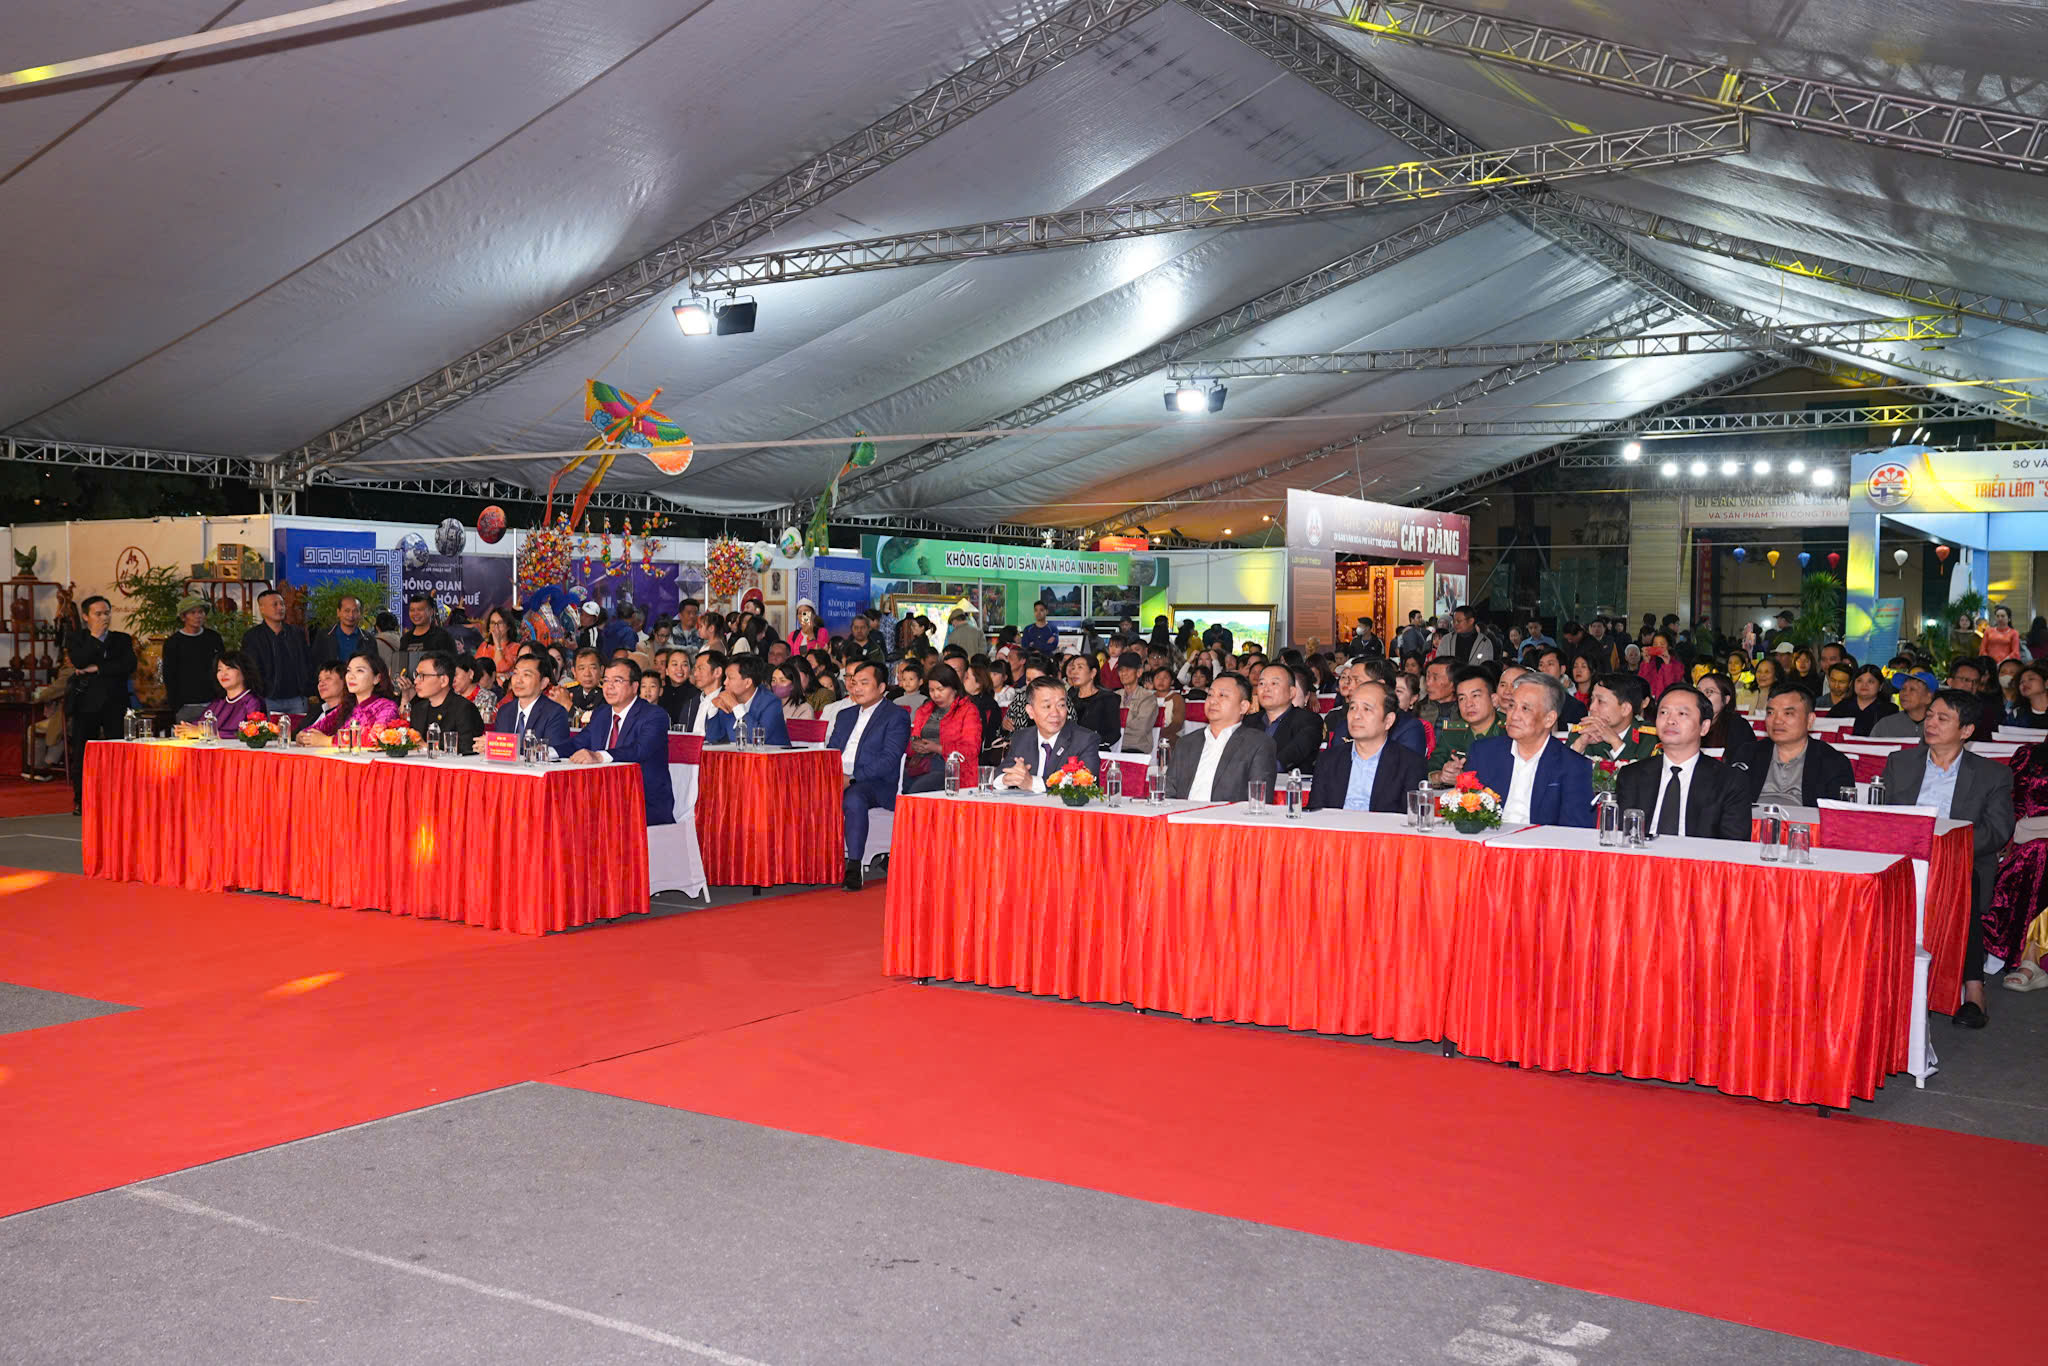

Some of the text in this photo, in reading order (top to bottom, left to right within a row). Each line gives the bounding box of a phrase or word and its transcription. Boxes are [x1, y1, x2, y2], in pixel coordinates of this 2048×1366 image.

[2013, 457, 2030, 469] SỞ
[1976, 473, 2006, 498] TRIỂN
[1401, 519, 1425, 553] CÁT
[1426, 517, 1460, 557] ĐẰNG
[946, 549, 1118, 576] KHÔNG GIAN DI SẢN VĂN HÓA NINH BÌNH
[403, 577, 462, 591] HÔNG GIAN
